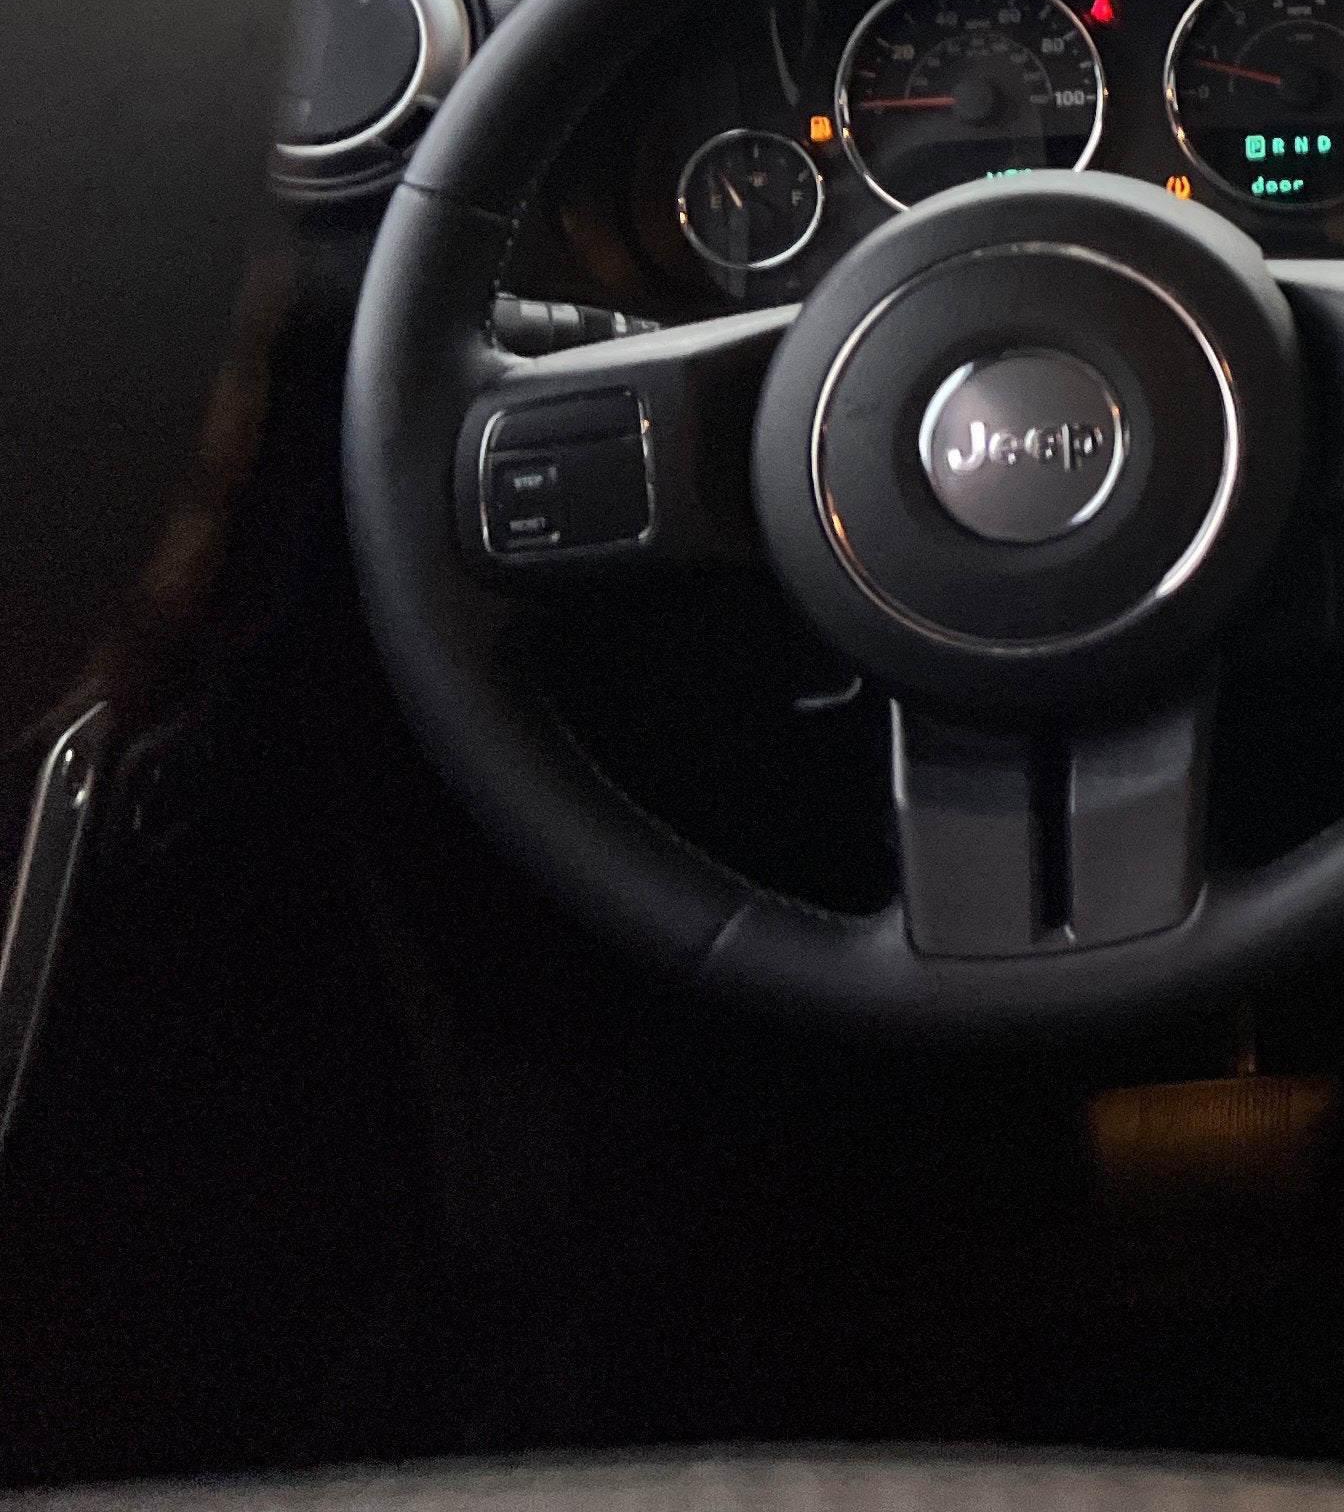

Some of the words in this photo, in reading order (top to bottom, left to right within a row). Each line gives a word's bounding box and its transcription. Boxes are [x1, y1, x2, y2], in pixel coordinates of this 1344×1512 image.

[1054, 90, 1086, 106] 100
[1271, 137, 1285, 155] R
[1294, 136, 1309, 154] N
[1317, 135, 1332, 155] D
[1251, 176, 1304, 196] door
[946, 421, 1104, 473] Jeep
